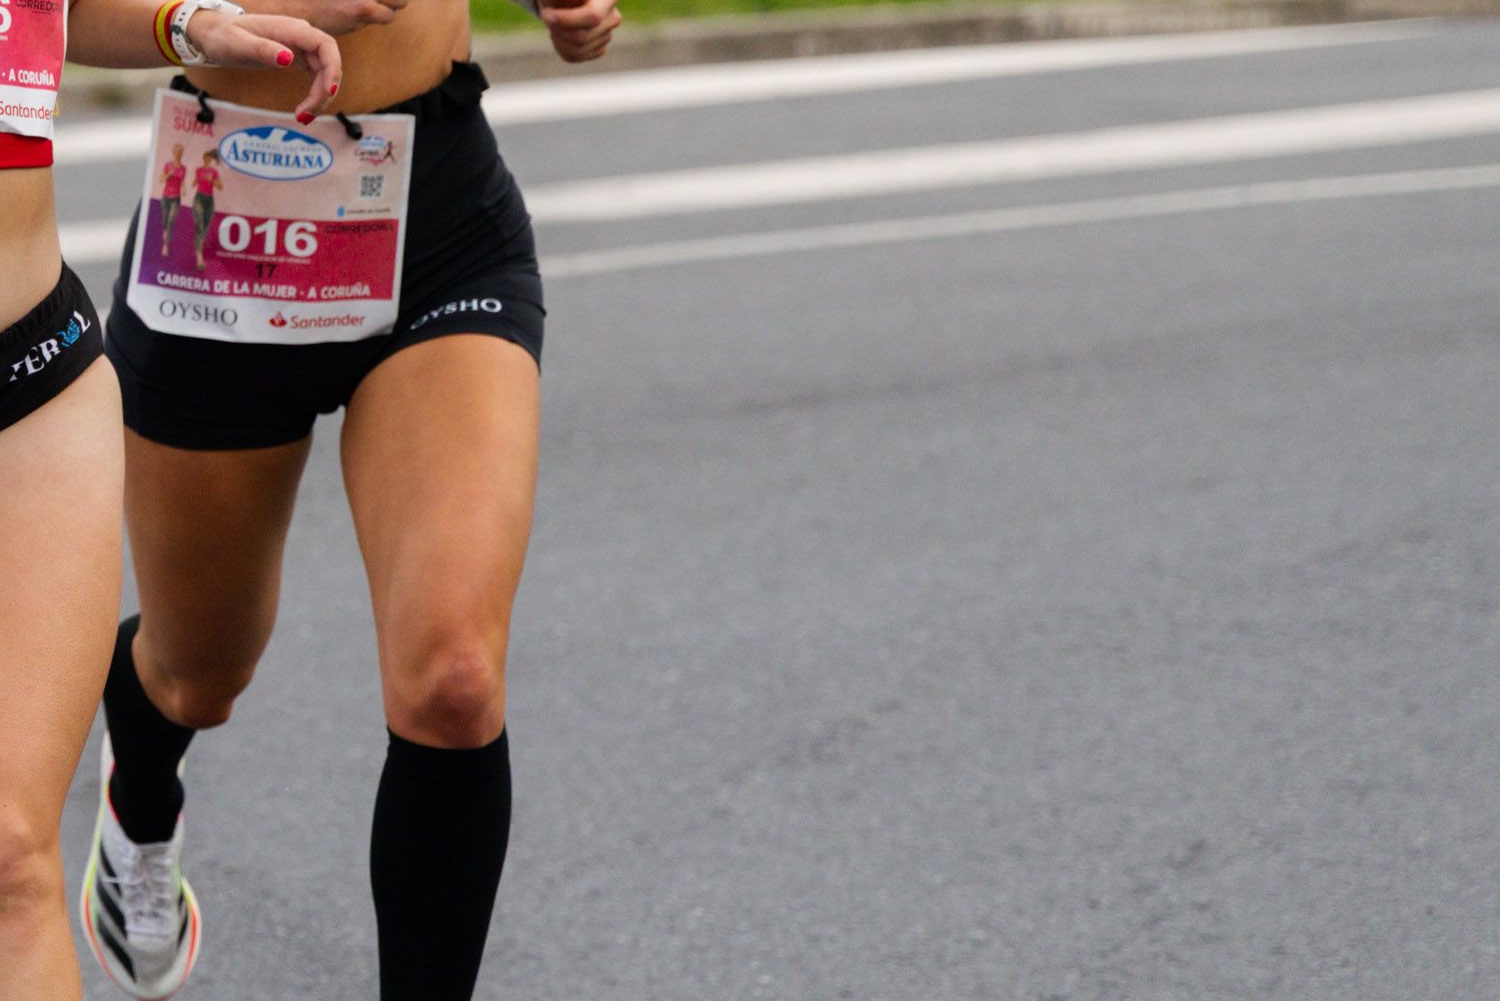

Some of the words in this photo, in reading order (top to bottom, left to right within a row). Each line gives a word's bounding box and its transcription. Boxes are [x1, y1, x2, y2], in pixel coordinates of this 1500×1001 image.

[8, 68, 16, 82] A
[18, 68, 55, 87] CORUÑA
[227, 139, 324, 169] ASTURIANA
[218, 215, 318, 258] 016
[157, 270, 210, 292] CARRERA
[214, 280, 230, 294] DE
[233, 281, 249, 294] LA
[253, 282, 296, 298] MUJER
[308, 286, 317, 298] A
[321, 281, 370, 298] CORUÑA
[256, 264, 277, 279] 17
[159, 299, 238, 327] OYSHO
[290, 314, 365, 331] Santander
[410, 298, 503, 330] OYSHO
